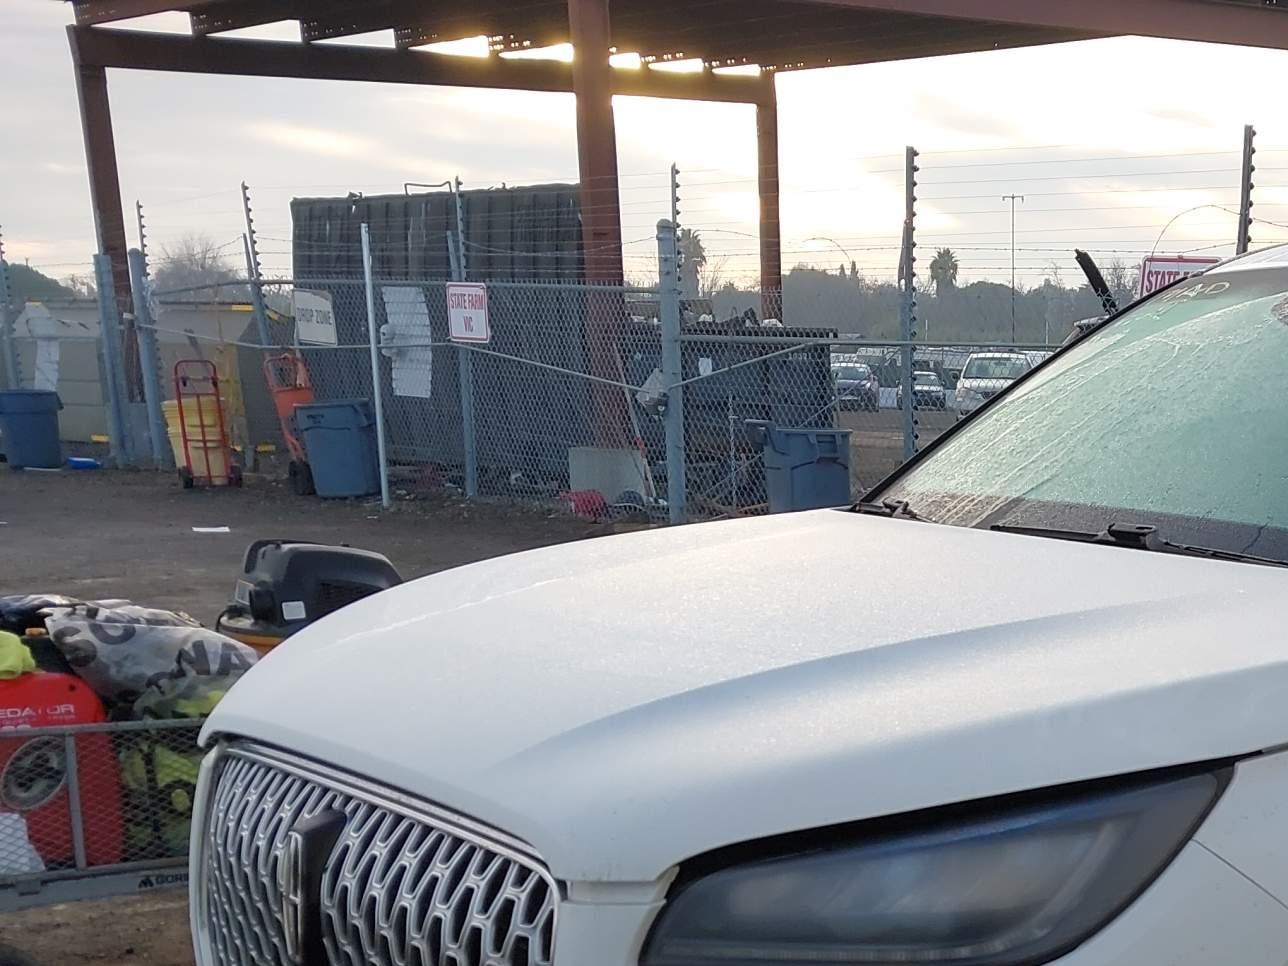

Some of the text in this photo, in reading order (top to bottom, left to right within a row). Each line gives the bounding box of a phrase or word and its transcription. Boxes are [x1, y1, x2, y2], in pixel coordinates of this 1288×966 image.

[450, 293, 484, 310] STATE FARM
[463, 315, 474, 332] VIC
